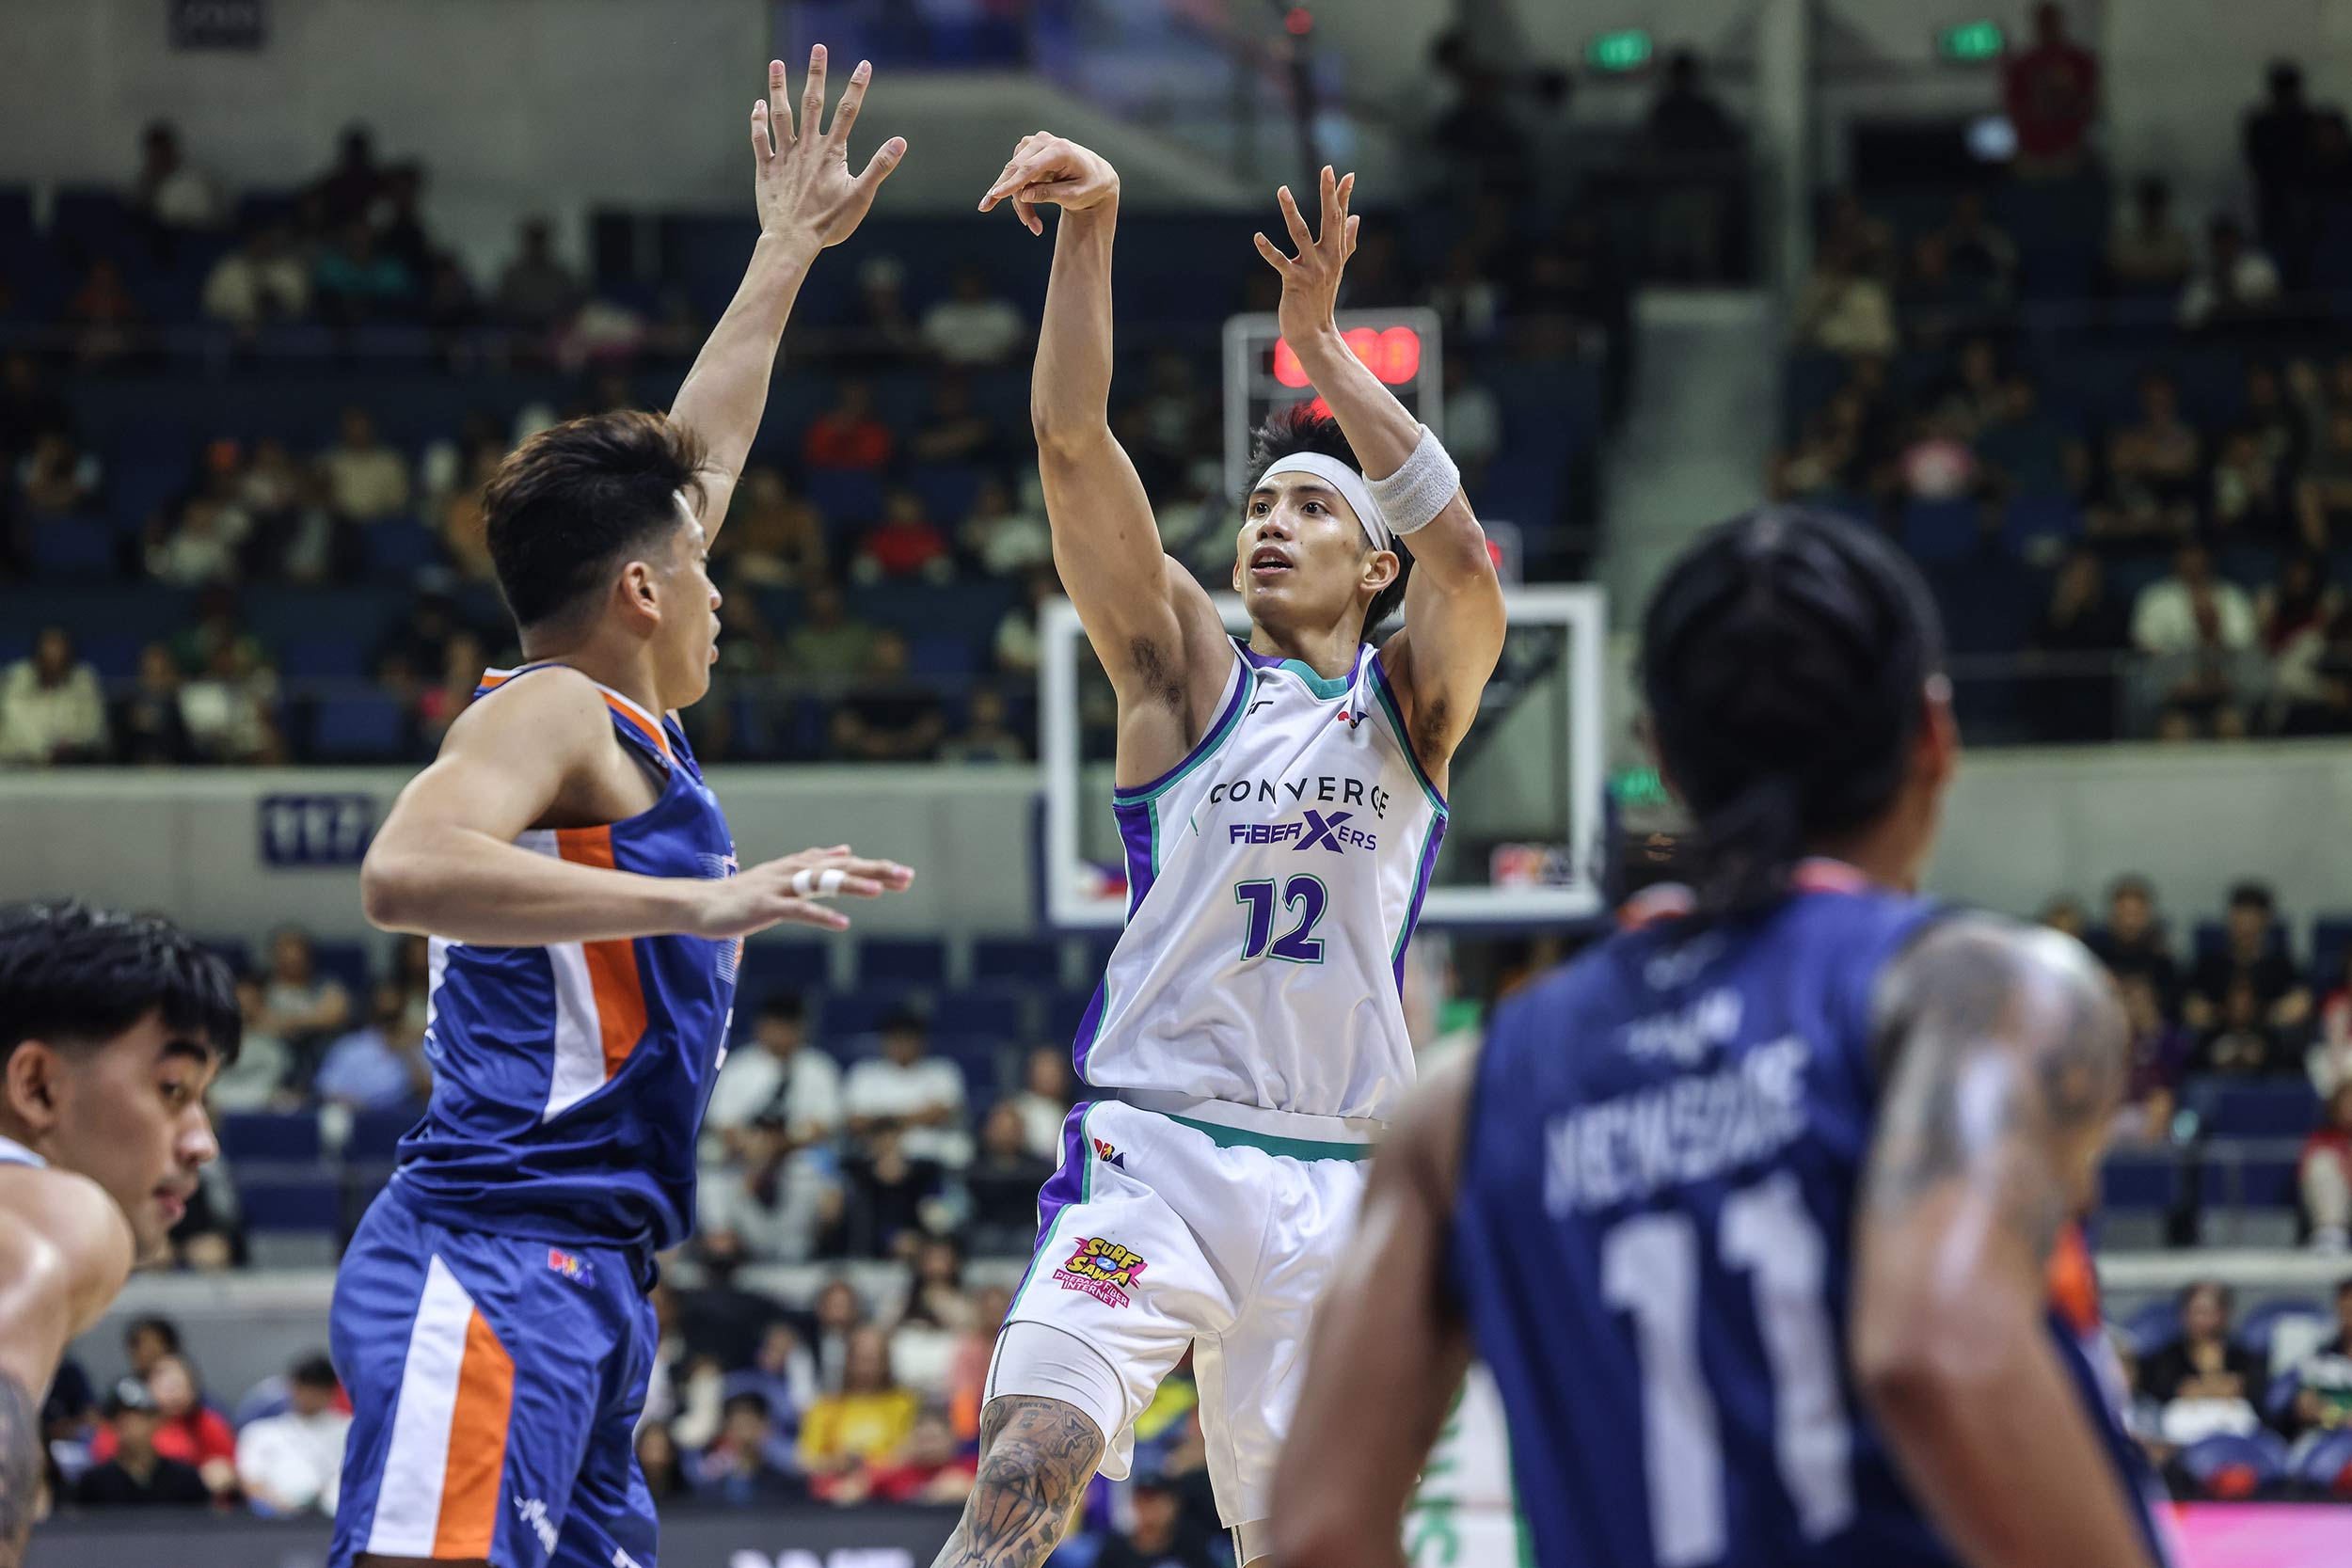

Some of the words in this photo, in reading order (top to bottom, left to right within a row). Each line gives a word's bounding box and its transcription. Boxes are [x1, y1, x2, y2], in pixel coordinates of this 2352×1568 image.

[1210, 776, 1390, 820] CONVERGE
[1233, 872, 1328, 965] 12
[1082, 1237, 1144, 1270] SURF
[1097, 1258, 1115, 1270] 2
[1065, 1256, 1131, 1288] SAWA
[1054, 1272, 1104, 1287] PREPAID
[1103, 1281, 1128, 1307] FIBER
[1062, 1280, 1117, 1308] INTERNET
[1601, 1171, 1860, 1568] 11
